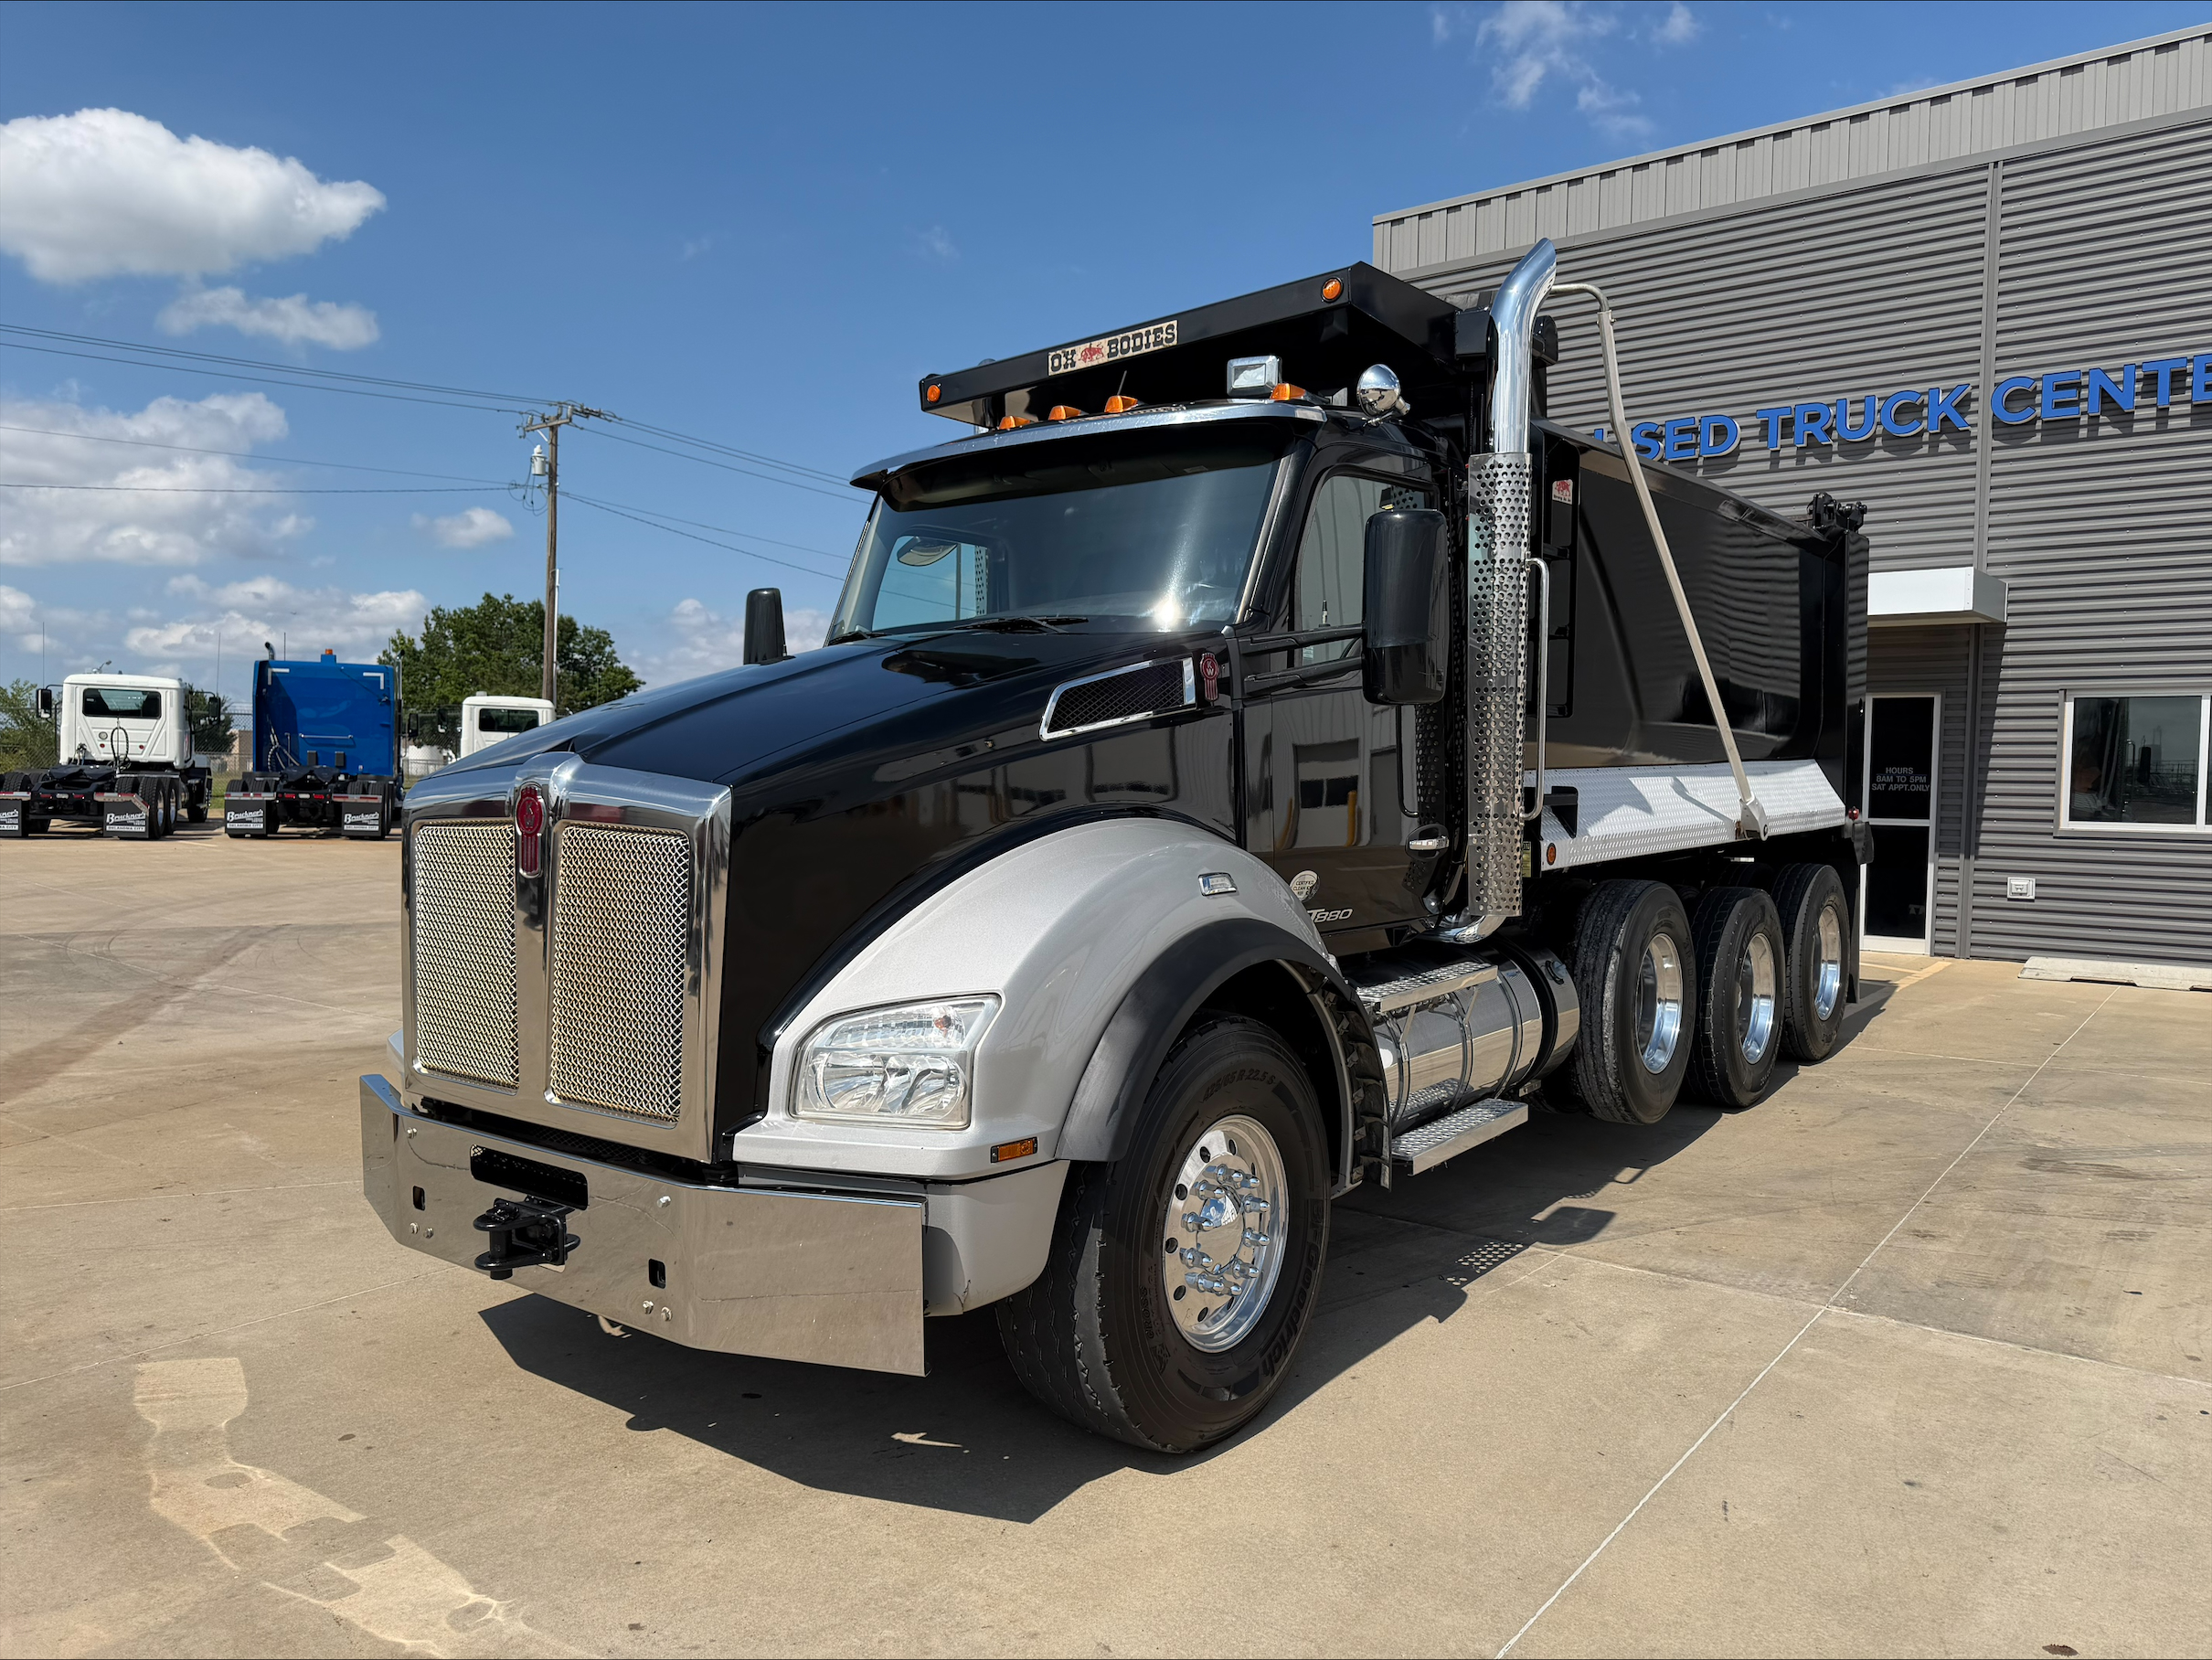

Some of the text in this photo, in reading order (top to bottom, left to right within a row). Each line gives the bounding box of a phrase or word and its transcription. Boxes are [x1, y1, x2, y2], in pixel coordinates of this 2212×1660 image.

[1050, 324, 1175, 373] OX BODIES
[1756, 383, 1971, 450] TRUCK
[1909, 775, 1927, 783] 5PM
[1307, 908, 1354, 923] T880
